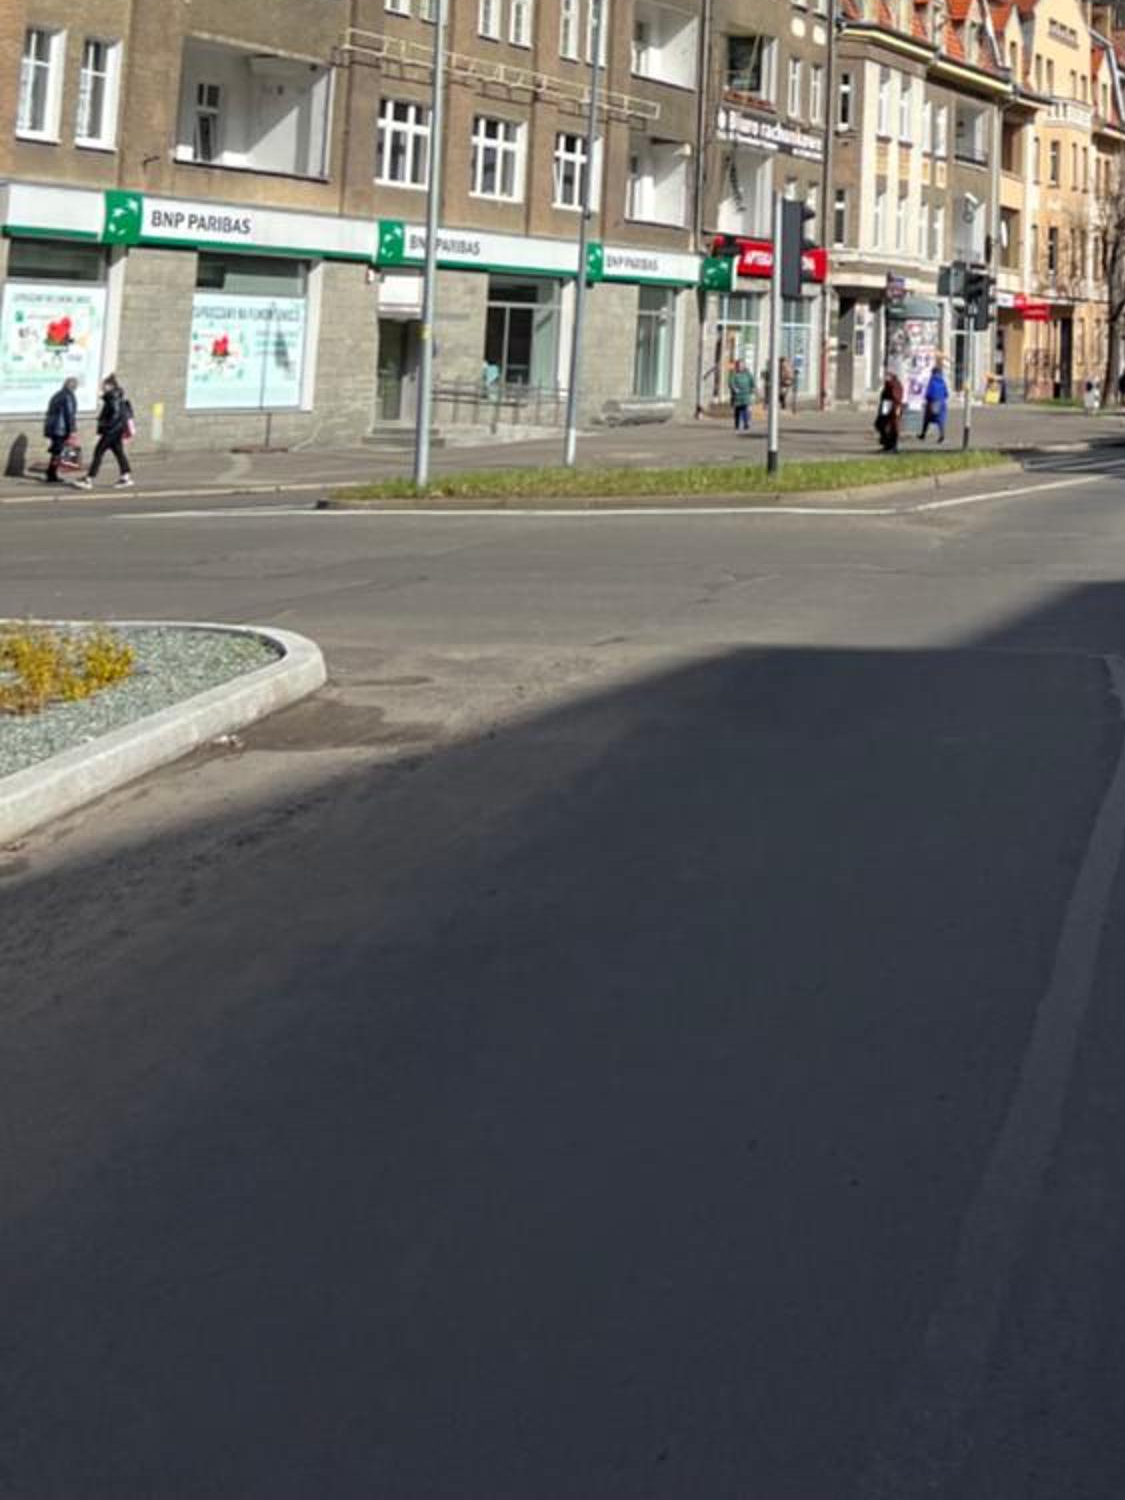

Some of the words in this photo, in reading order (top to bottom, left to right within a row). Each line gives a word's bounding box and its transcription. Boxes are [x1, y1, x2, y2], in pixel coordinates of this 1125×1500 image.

[151, 209, 185, 229] BNP
[187, 213, 252, 235] PARIBAS
[434, 237, 480, 256] PARIBAS
